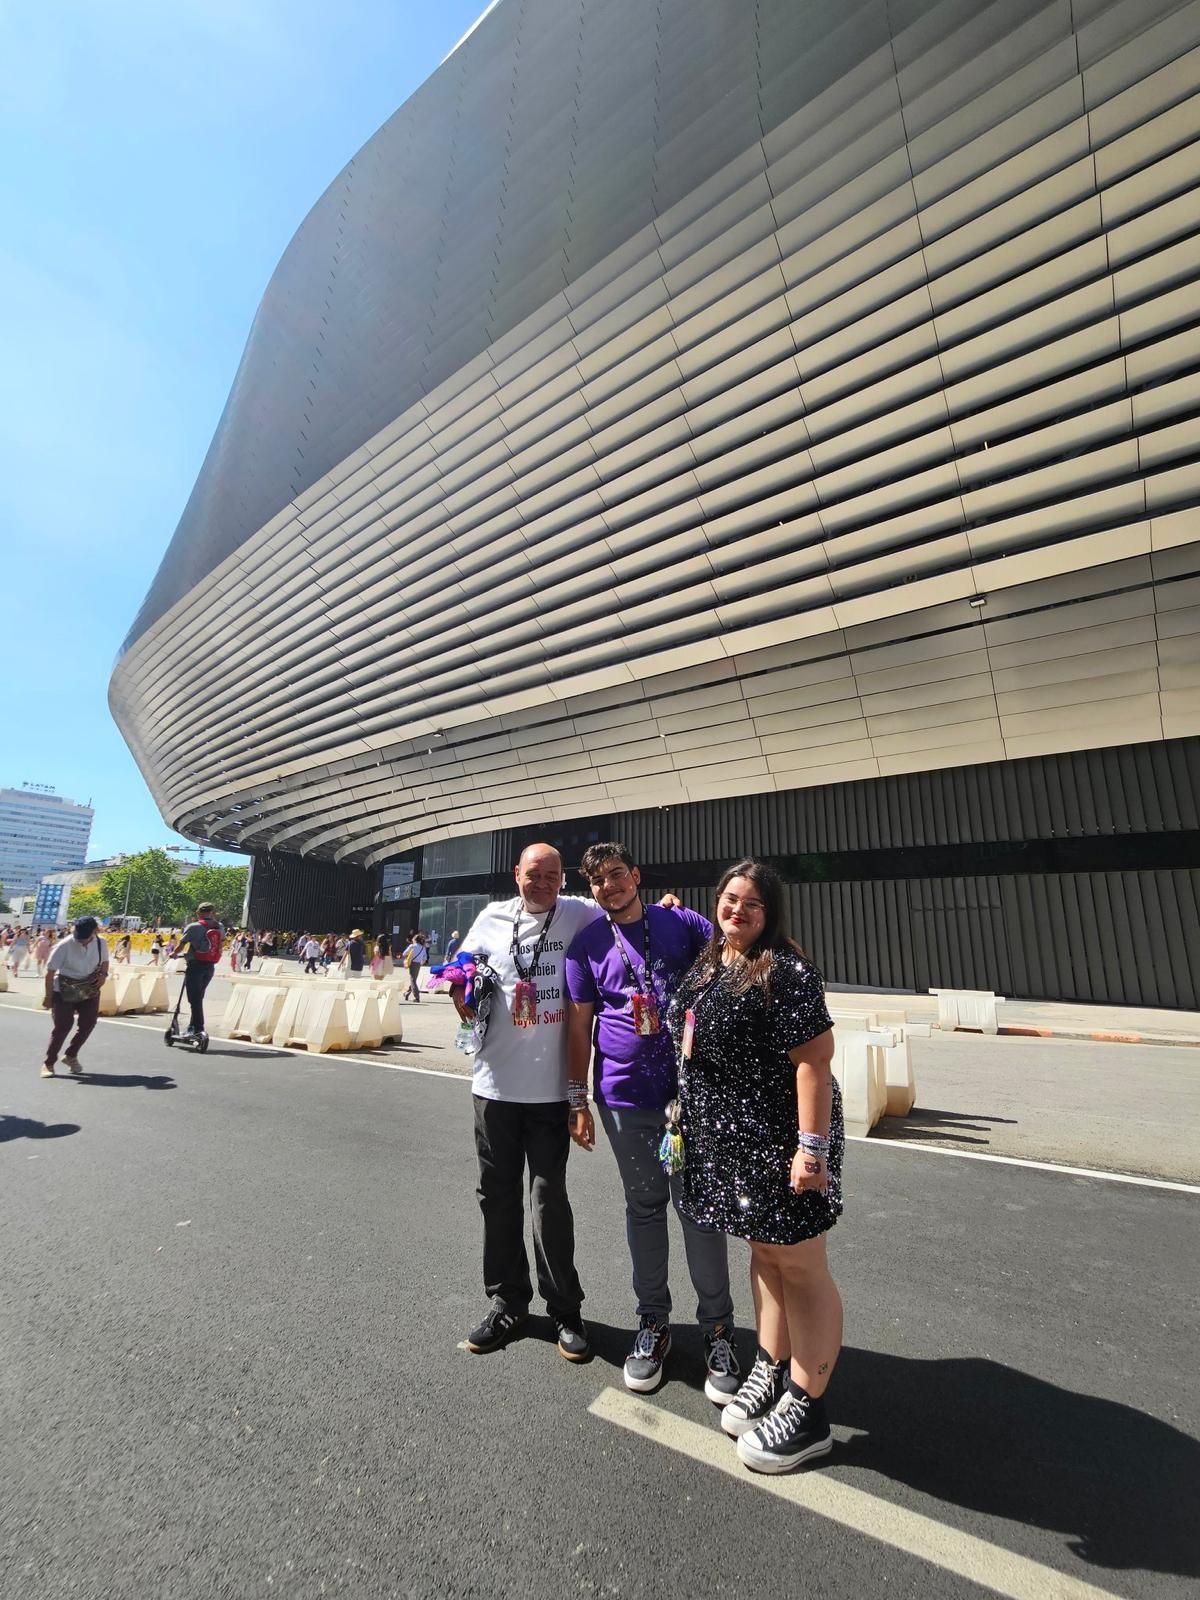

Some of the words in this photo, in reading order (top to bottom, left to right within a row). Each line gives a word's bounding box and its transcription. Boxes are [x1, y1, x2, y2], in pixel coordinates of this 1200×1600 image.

[517, 943, 531, 955] los
[533, 940, 563, 953] pdres
[521, 962, 556, 976] abién
[535, 986, 560, 1003] gusta
[543, 1008, 565, 1025] Swift
